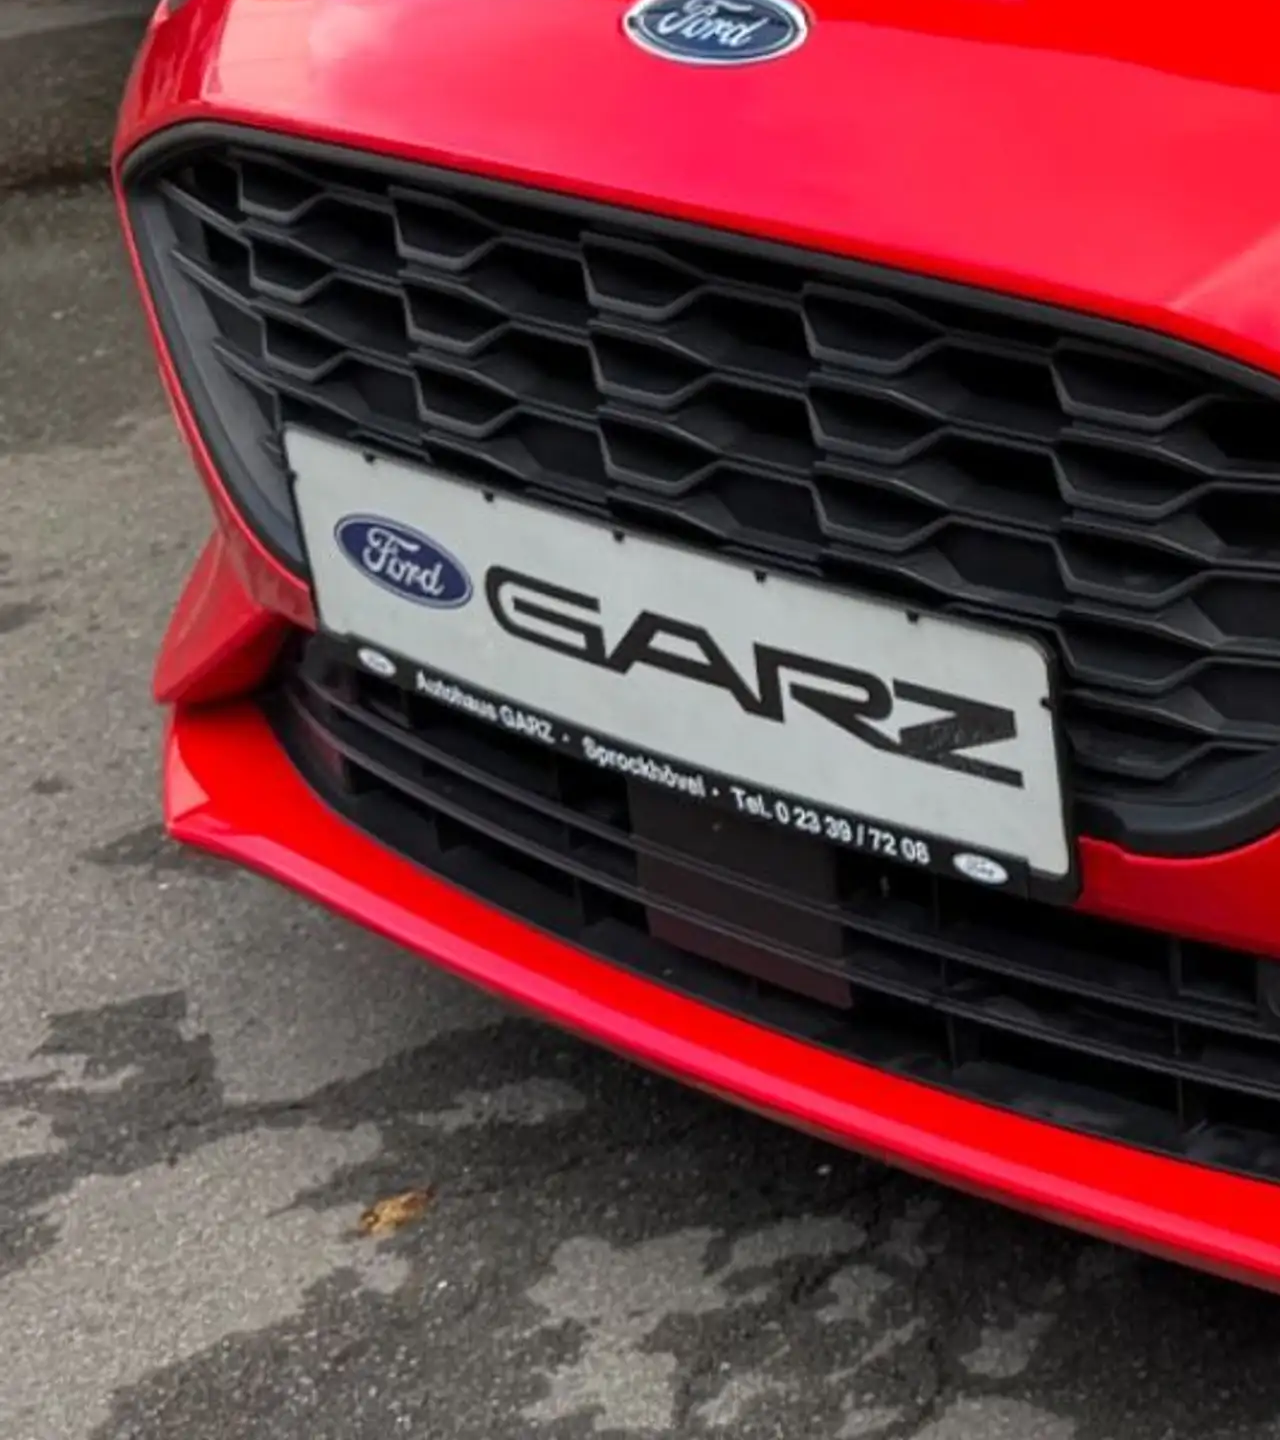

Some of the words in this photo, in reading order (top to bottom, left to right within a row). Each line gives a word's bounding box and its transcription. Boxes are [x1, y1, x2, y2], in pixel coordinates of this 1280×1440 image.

[362, 527, 446, 596] Ford
[416, 670, 498, 722] Autohaus
[500, 704, 556, 744] GARZ
[730, 786, 773, 820] Tel.
[485, 565, 1024, 788] GARZ
